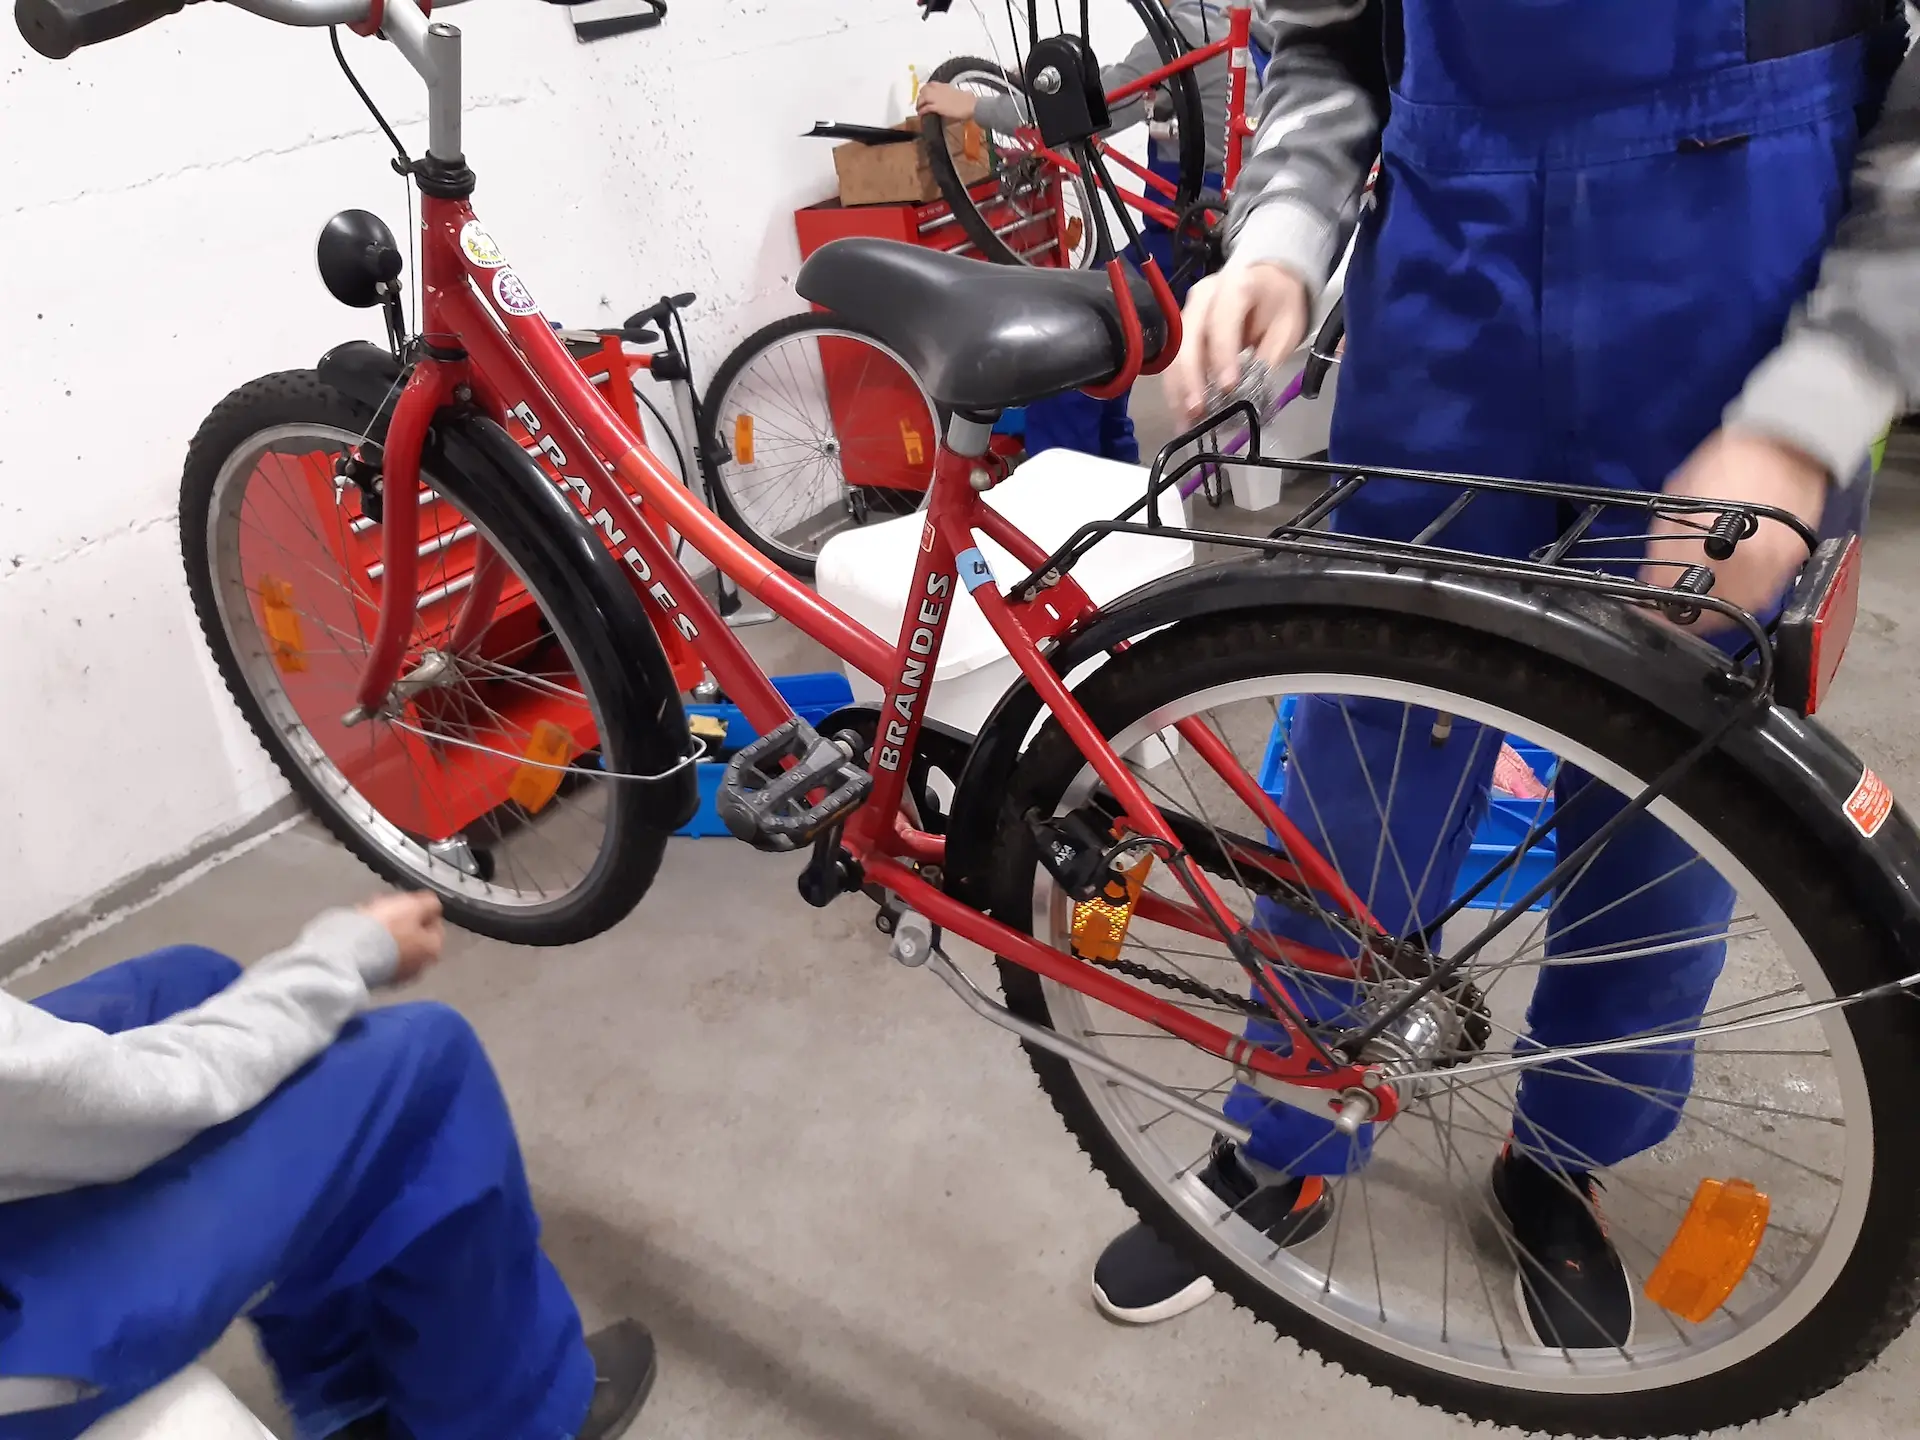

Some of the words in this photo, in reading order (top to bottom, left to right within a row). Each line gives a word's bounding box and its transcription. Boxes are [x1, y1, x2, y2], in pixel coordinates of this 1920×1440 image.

[511, 399, 700, 643] BRANDES
[878, 571, 951, 773] BRANDES
[1054, 844, 1073, 866] AXA
